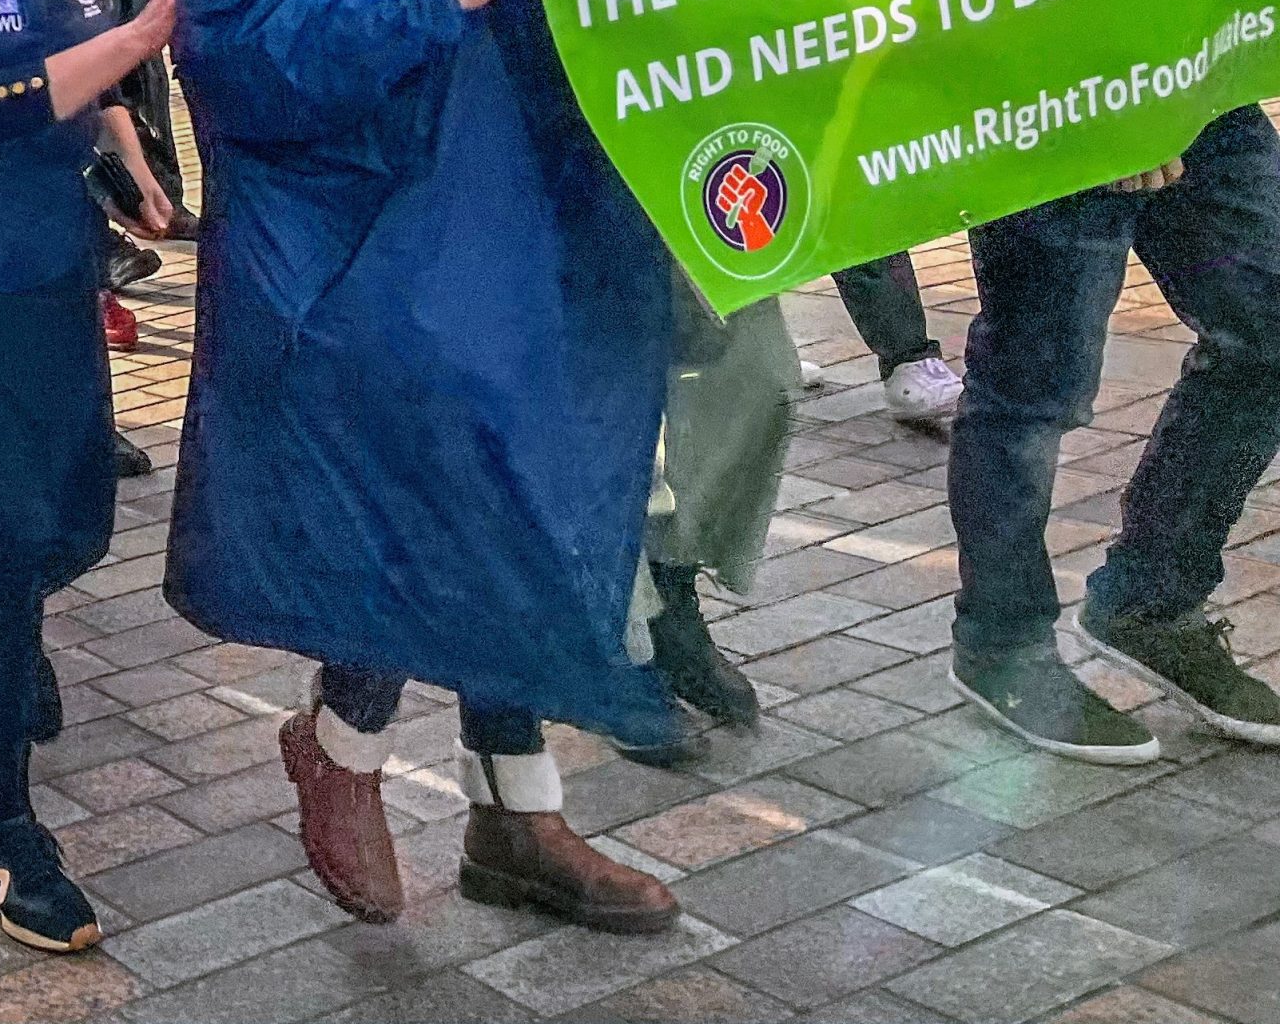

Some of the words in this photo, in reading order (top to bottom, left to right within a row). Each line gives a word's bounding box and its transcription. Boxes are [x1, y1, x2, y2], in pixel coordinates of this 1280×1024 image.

[615, 47, 733, 120] AND
[688, 137, 726, 182] RIGHT
[726, 130, 749, 145] TO
[752, 130, 790, 160] FOOD
